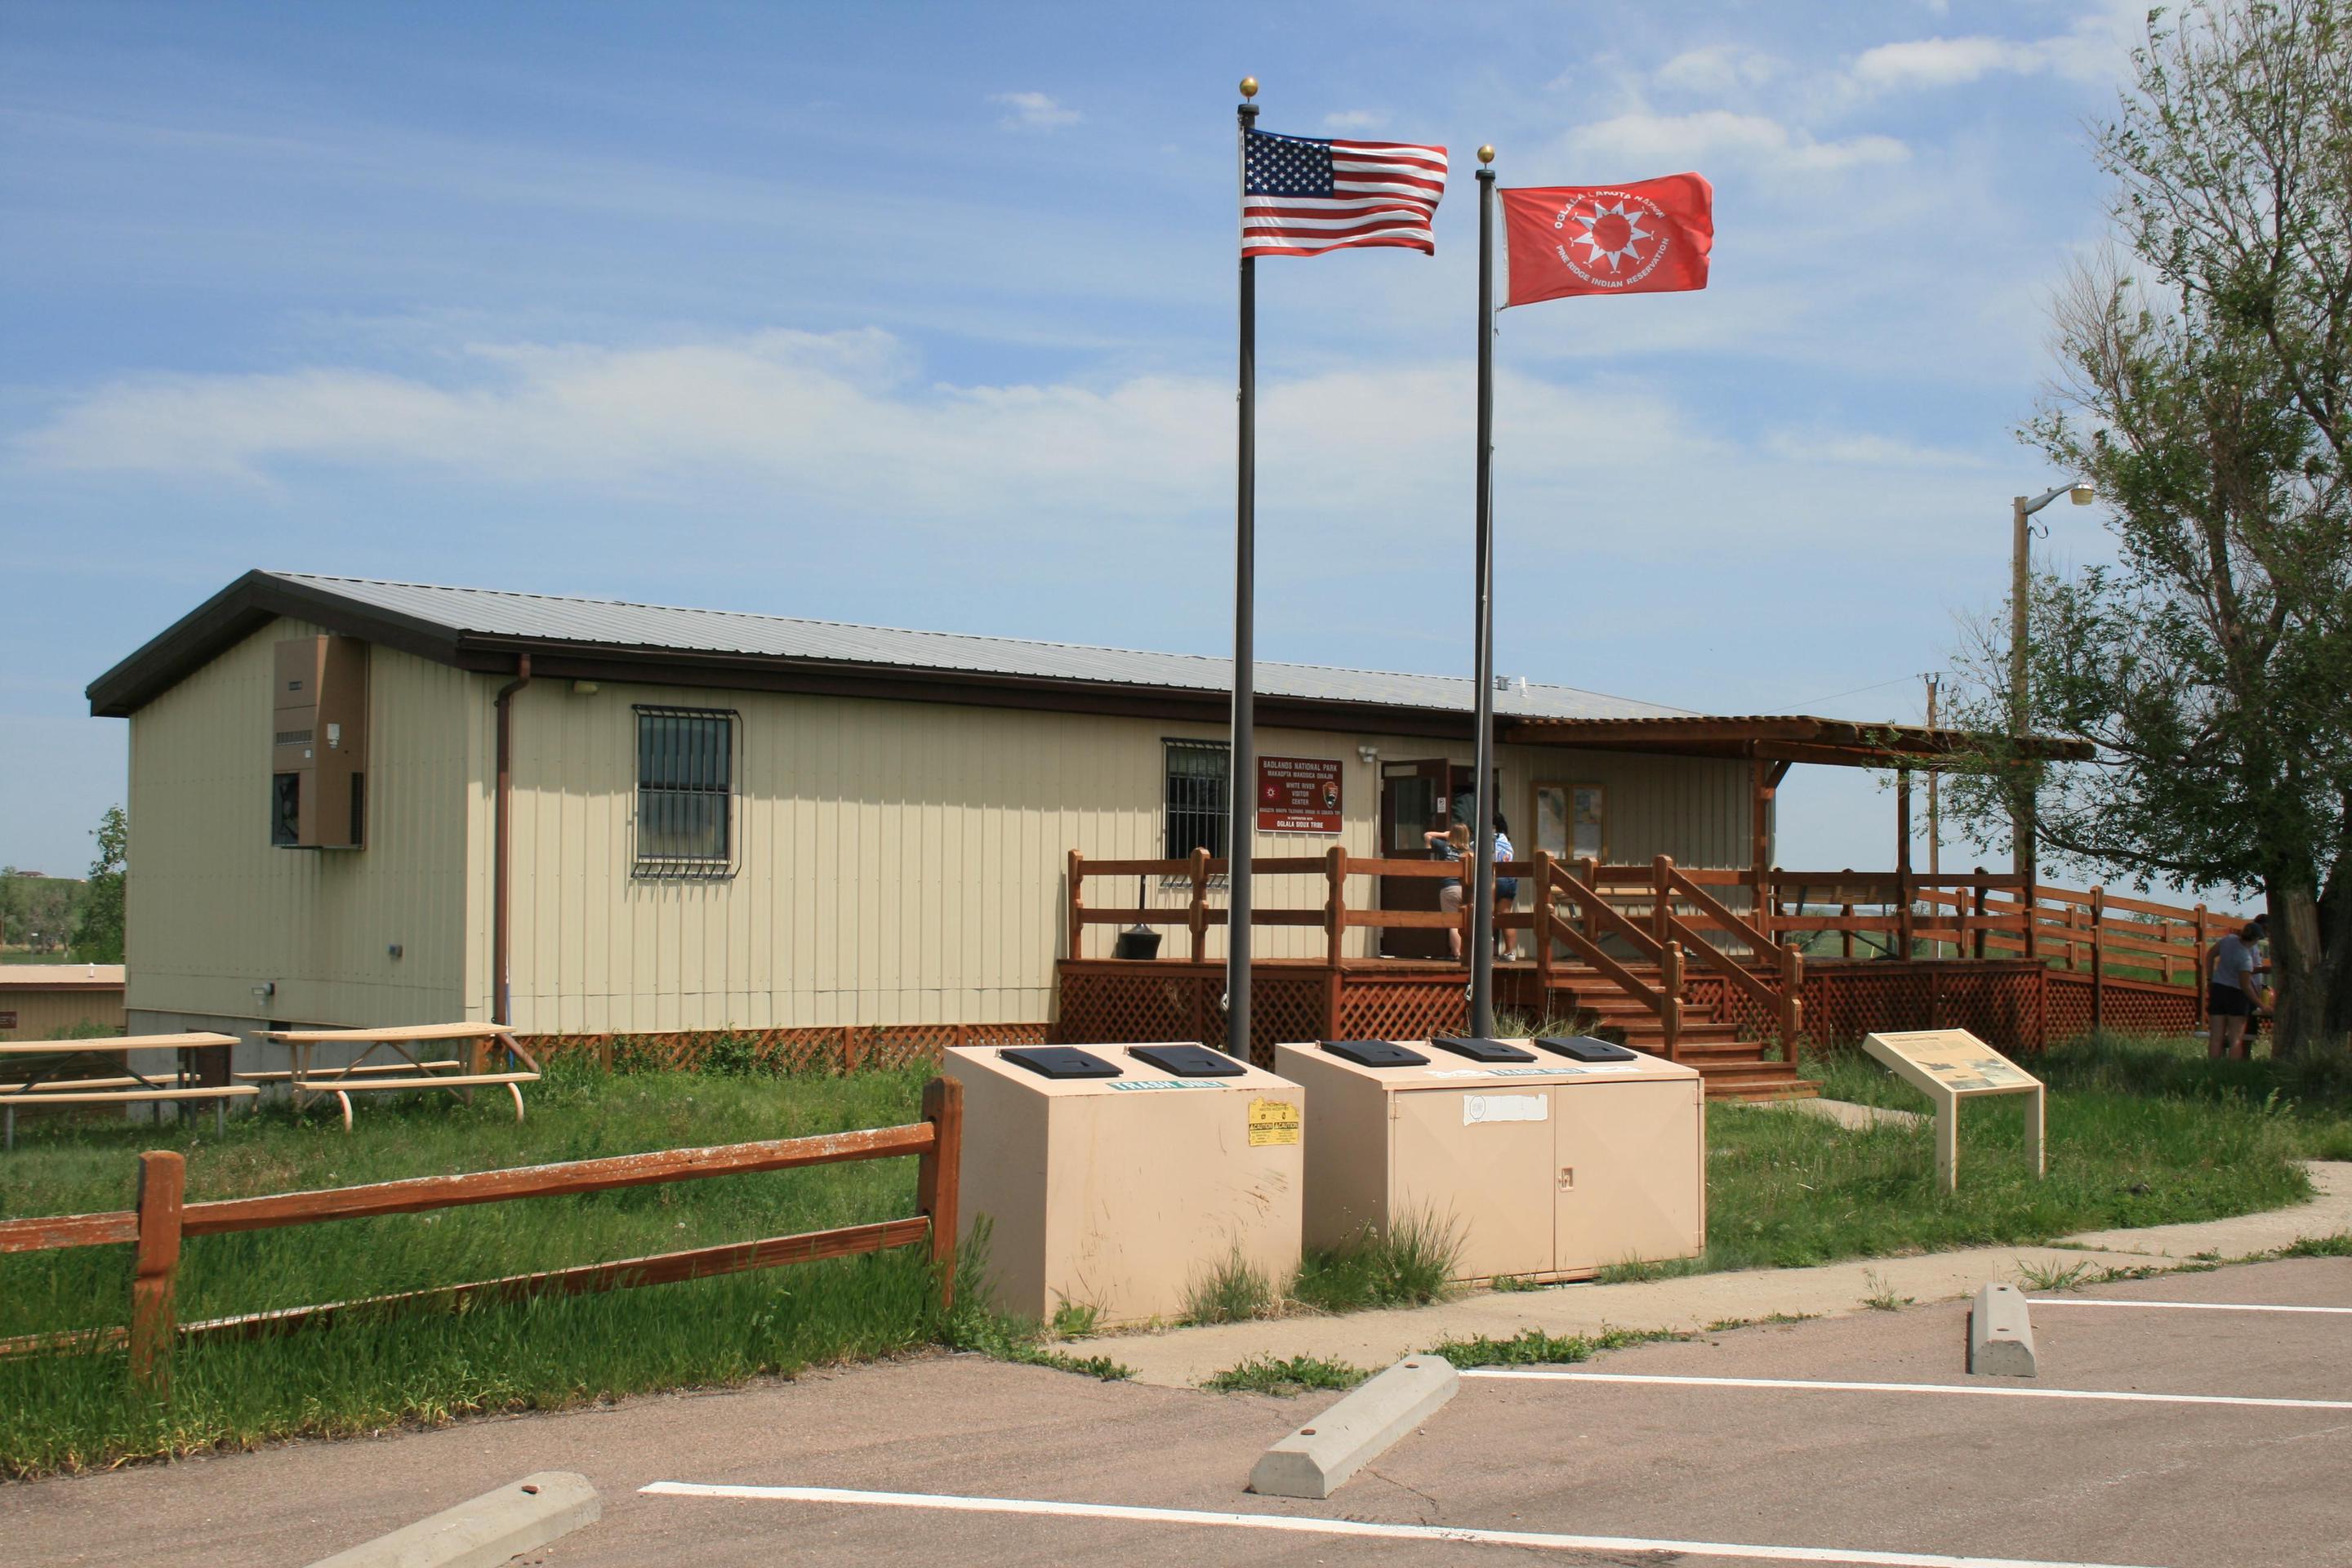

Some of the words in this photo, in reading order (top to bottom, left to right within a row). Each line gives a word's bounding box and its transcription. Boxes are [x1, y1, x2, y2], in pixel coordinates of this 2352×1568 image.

[1554, 193, 1586, 229] OGLALA
[1633, 195, 1666, 219] NATION
[1556, 244, 1570, 265] PINE
[1566, 261, 1589, 281] RIDGE
[1591, 278, 1623, 287] INDIAN
[1627, 237, 1670, 285] RESERVATION
[1112, 1080, 1178, 1090] TRASH
